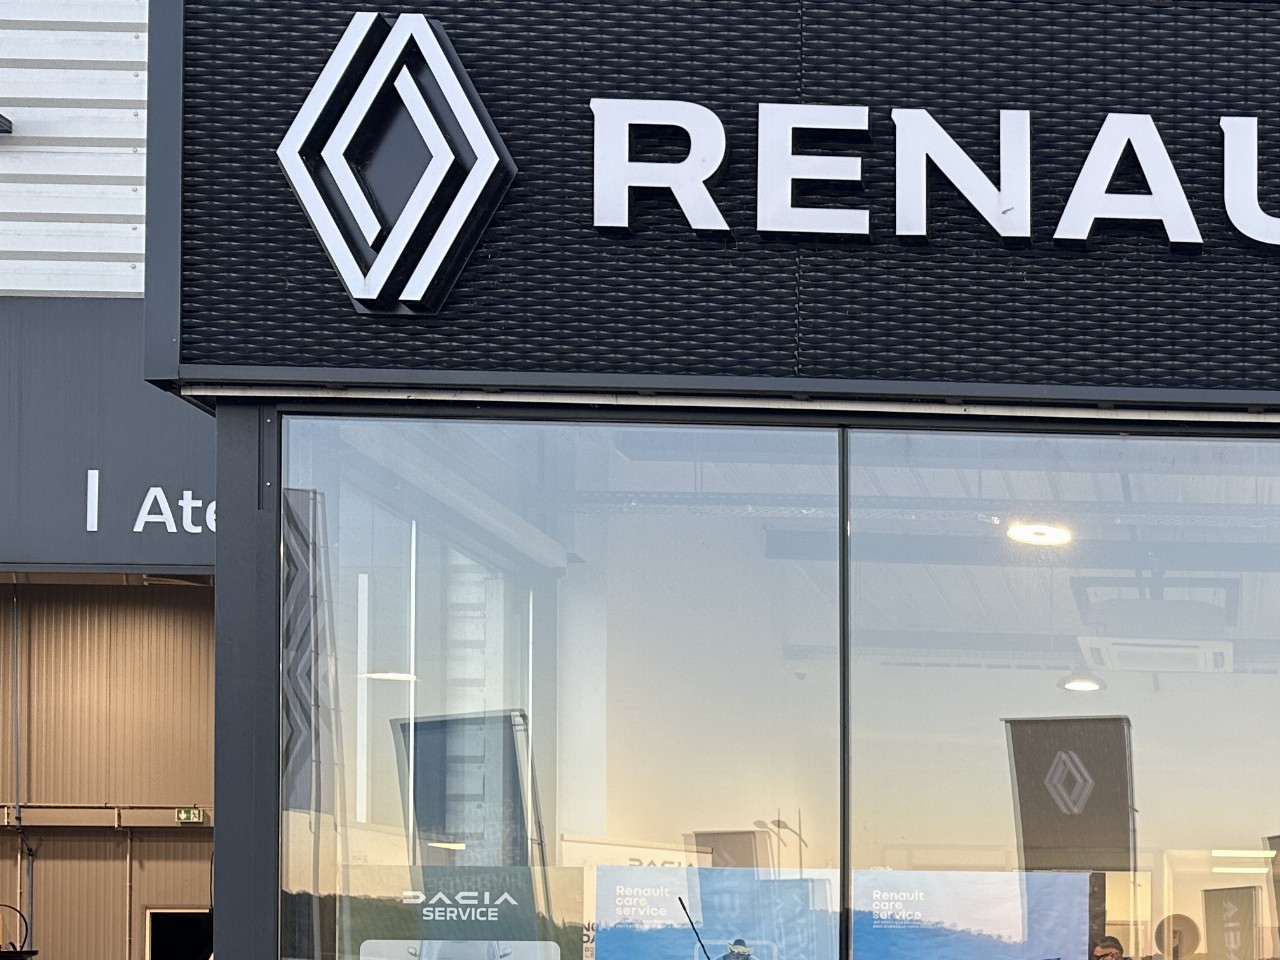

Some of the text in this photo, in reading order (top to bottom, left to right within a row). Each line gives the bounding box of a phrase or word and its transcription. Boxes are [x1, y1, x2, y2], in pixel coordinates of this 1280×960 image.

[616, 886, 670, 897] Renault
[873, 890, 925, 901] Renault
[402, 891, 518, 905] DACIA
[616, 897, 648, 906] care
[615, 905, 668, 917] service
[872, 901, 903, 910] care
[422, 907, 499, 921] SERVICE
[872, 909, 922, 920] service
